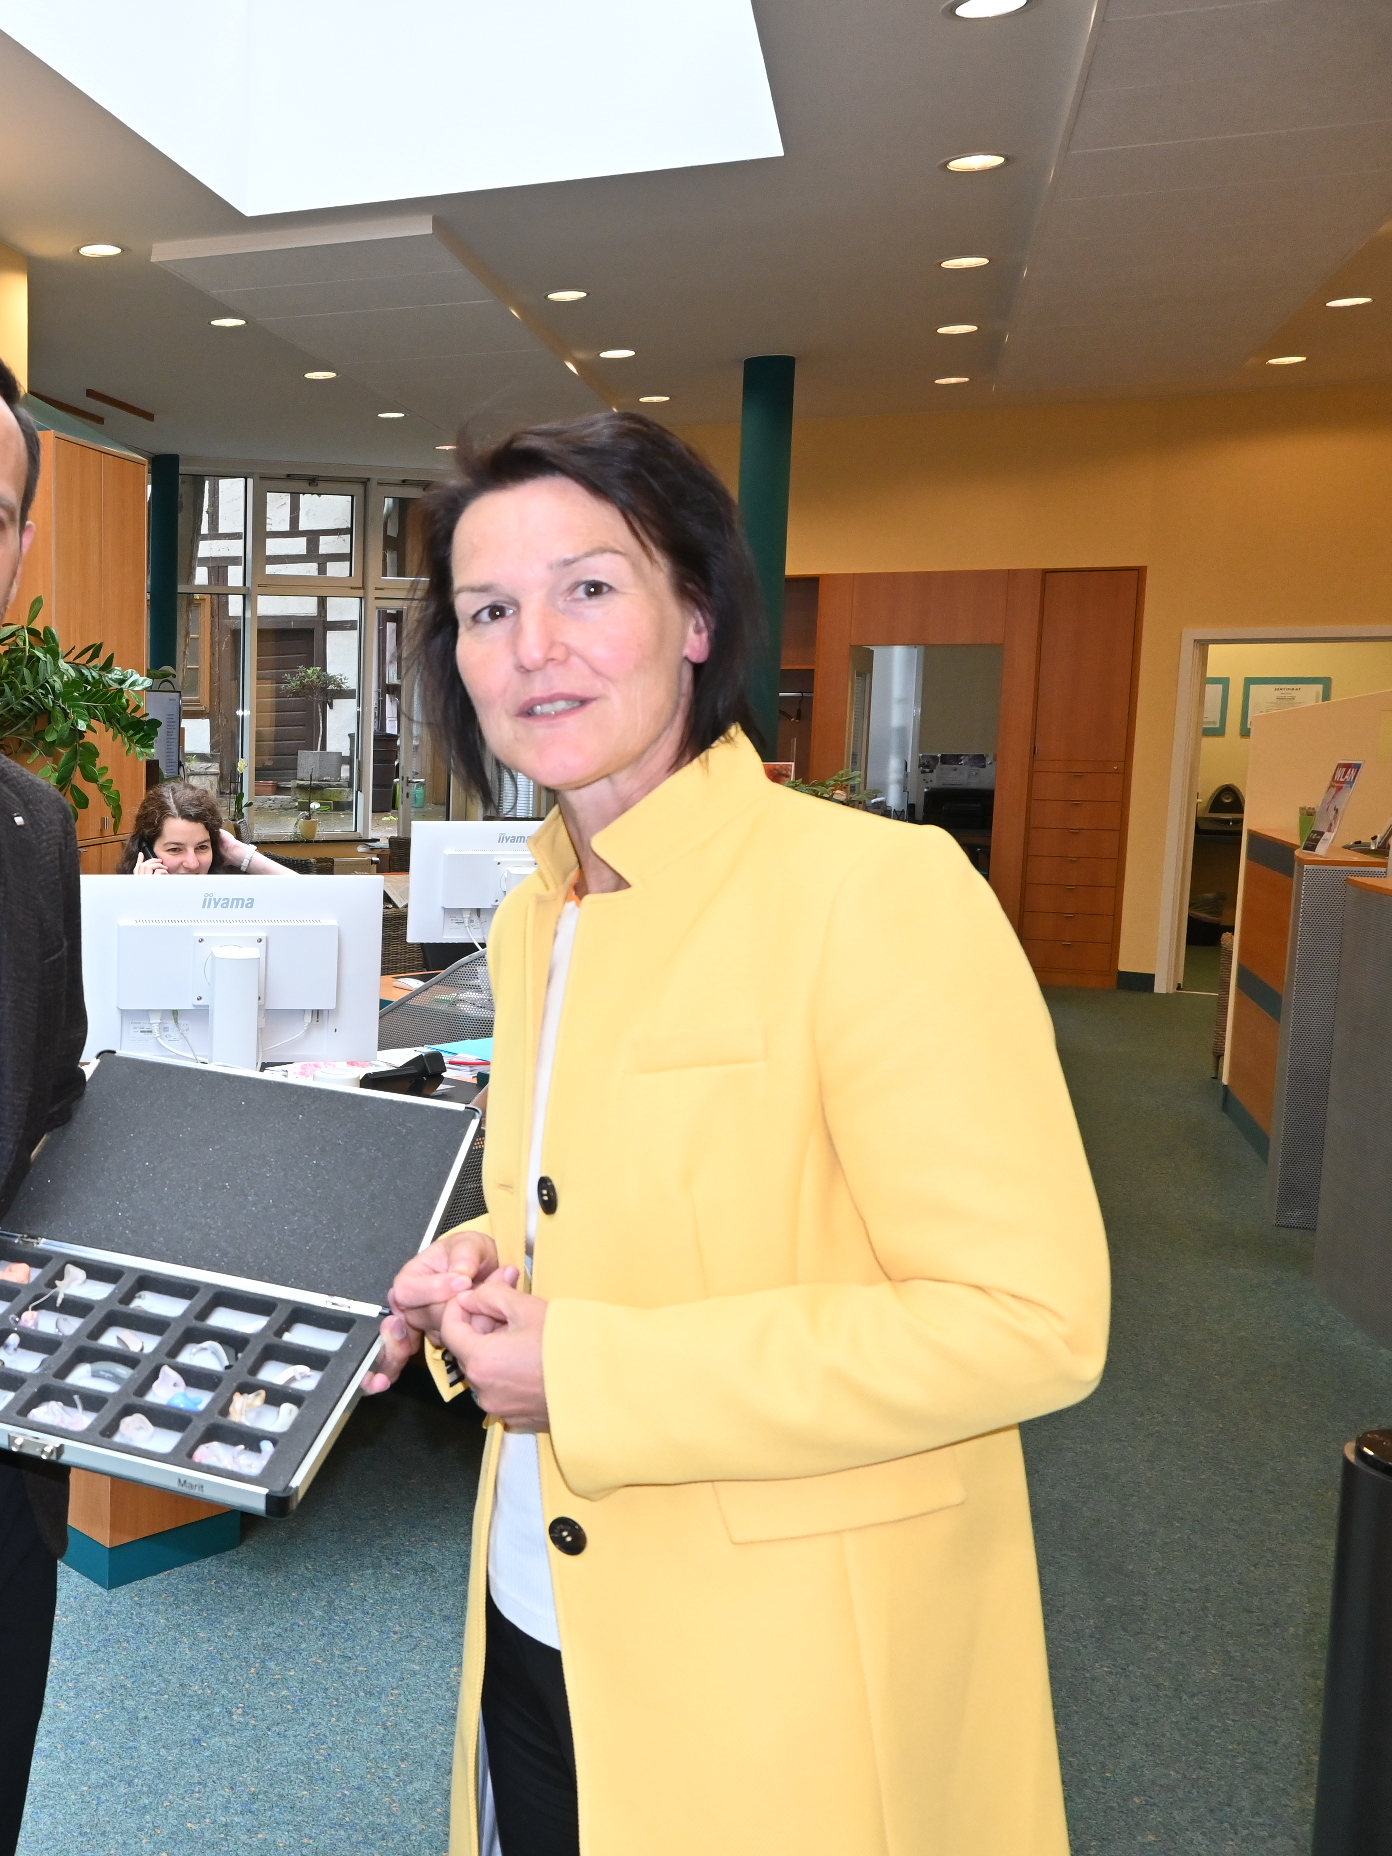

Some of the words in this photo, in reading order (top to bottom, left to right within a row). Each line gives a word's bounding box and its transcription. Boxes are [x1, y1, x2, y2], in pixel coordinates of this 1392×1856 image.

[1334, 767, 1358, 782] WLAN
[497, 832, 532, 844] iiyam
[201, 892, 255, 909] iiyama
